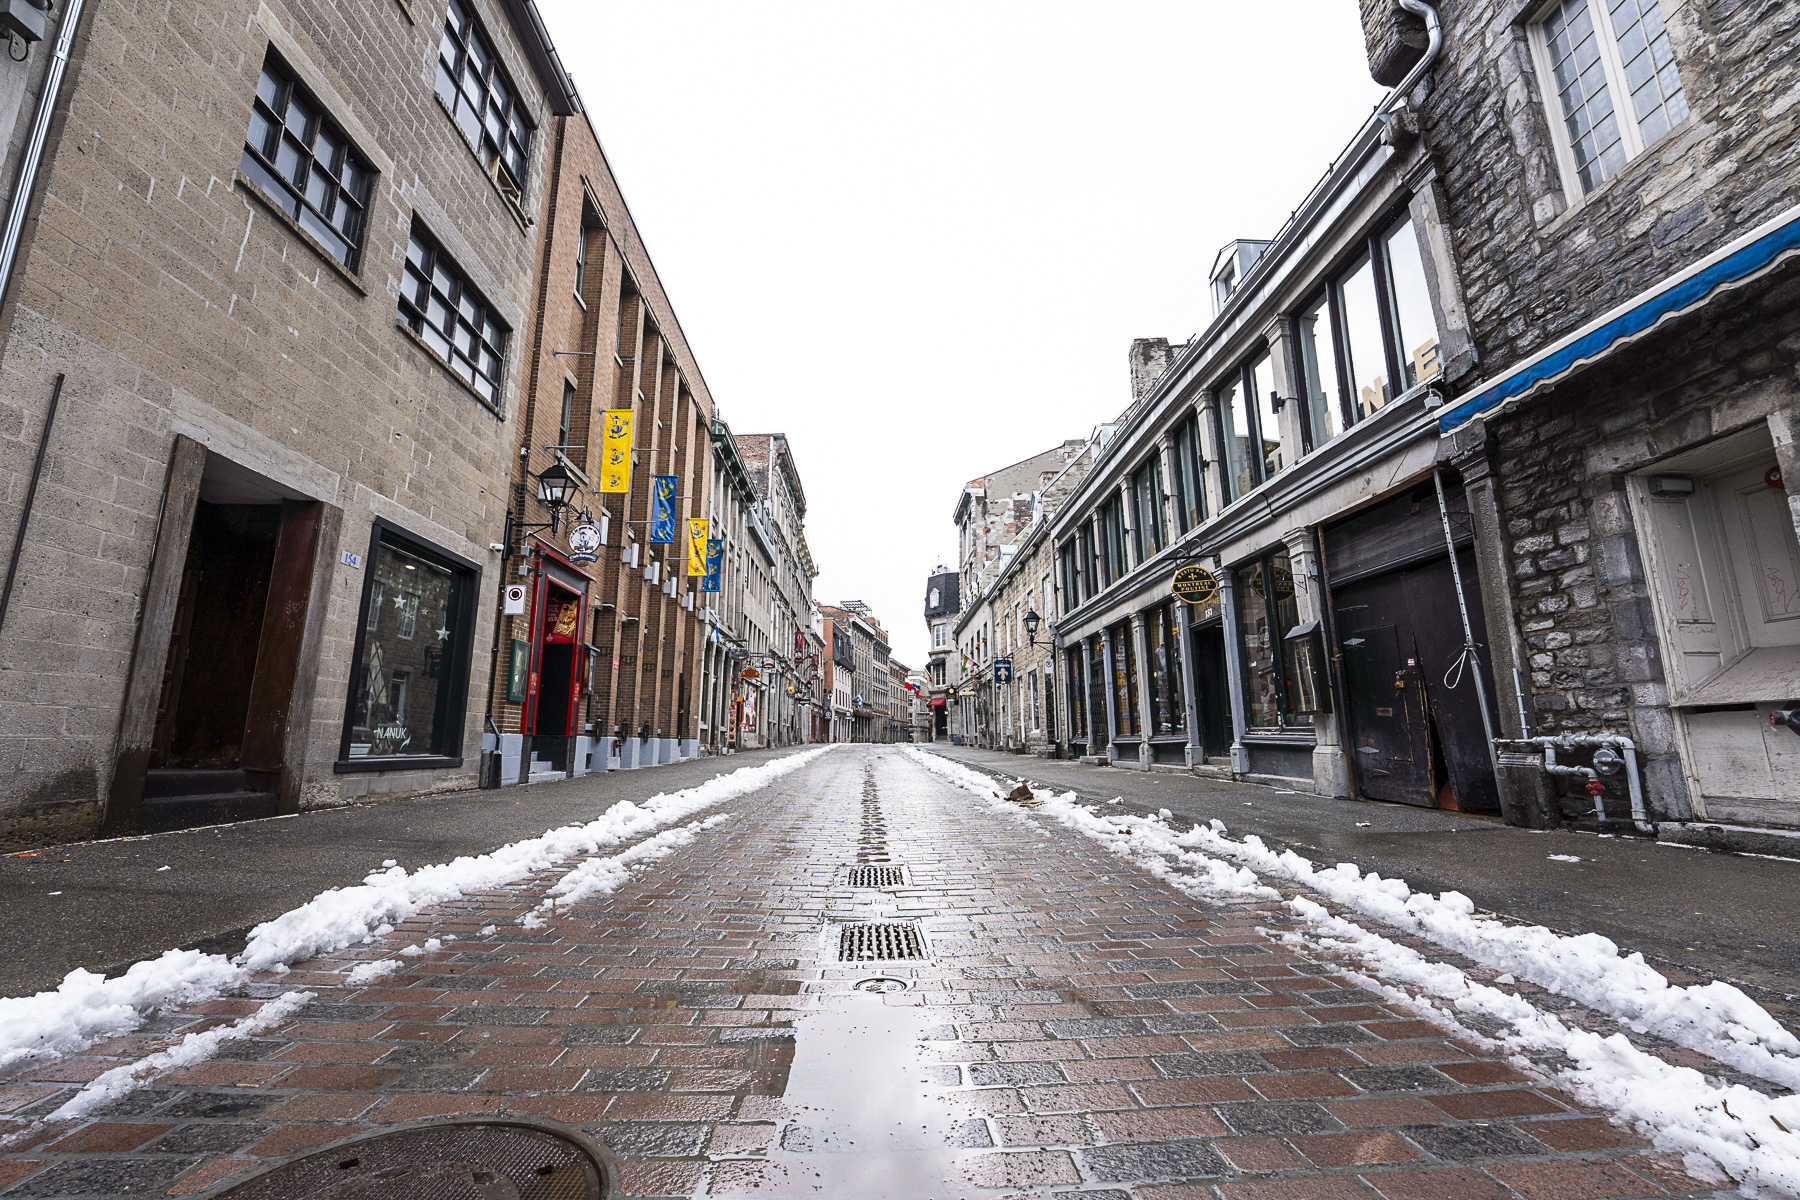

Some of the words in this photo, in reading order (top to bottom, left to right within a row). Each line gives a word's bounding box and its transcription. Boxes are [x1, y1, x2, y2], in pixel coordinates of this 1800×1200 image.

[344, 553, 357, 565] 154
[1178, 569, 1194, 579] RESTO
[376, 726, 407, 739] NANUK
